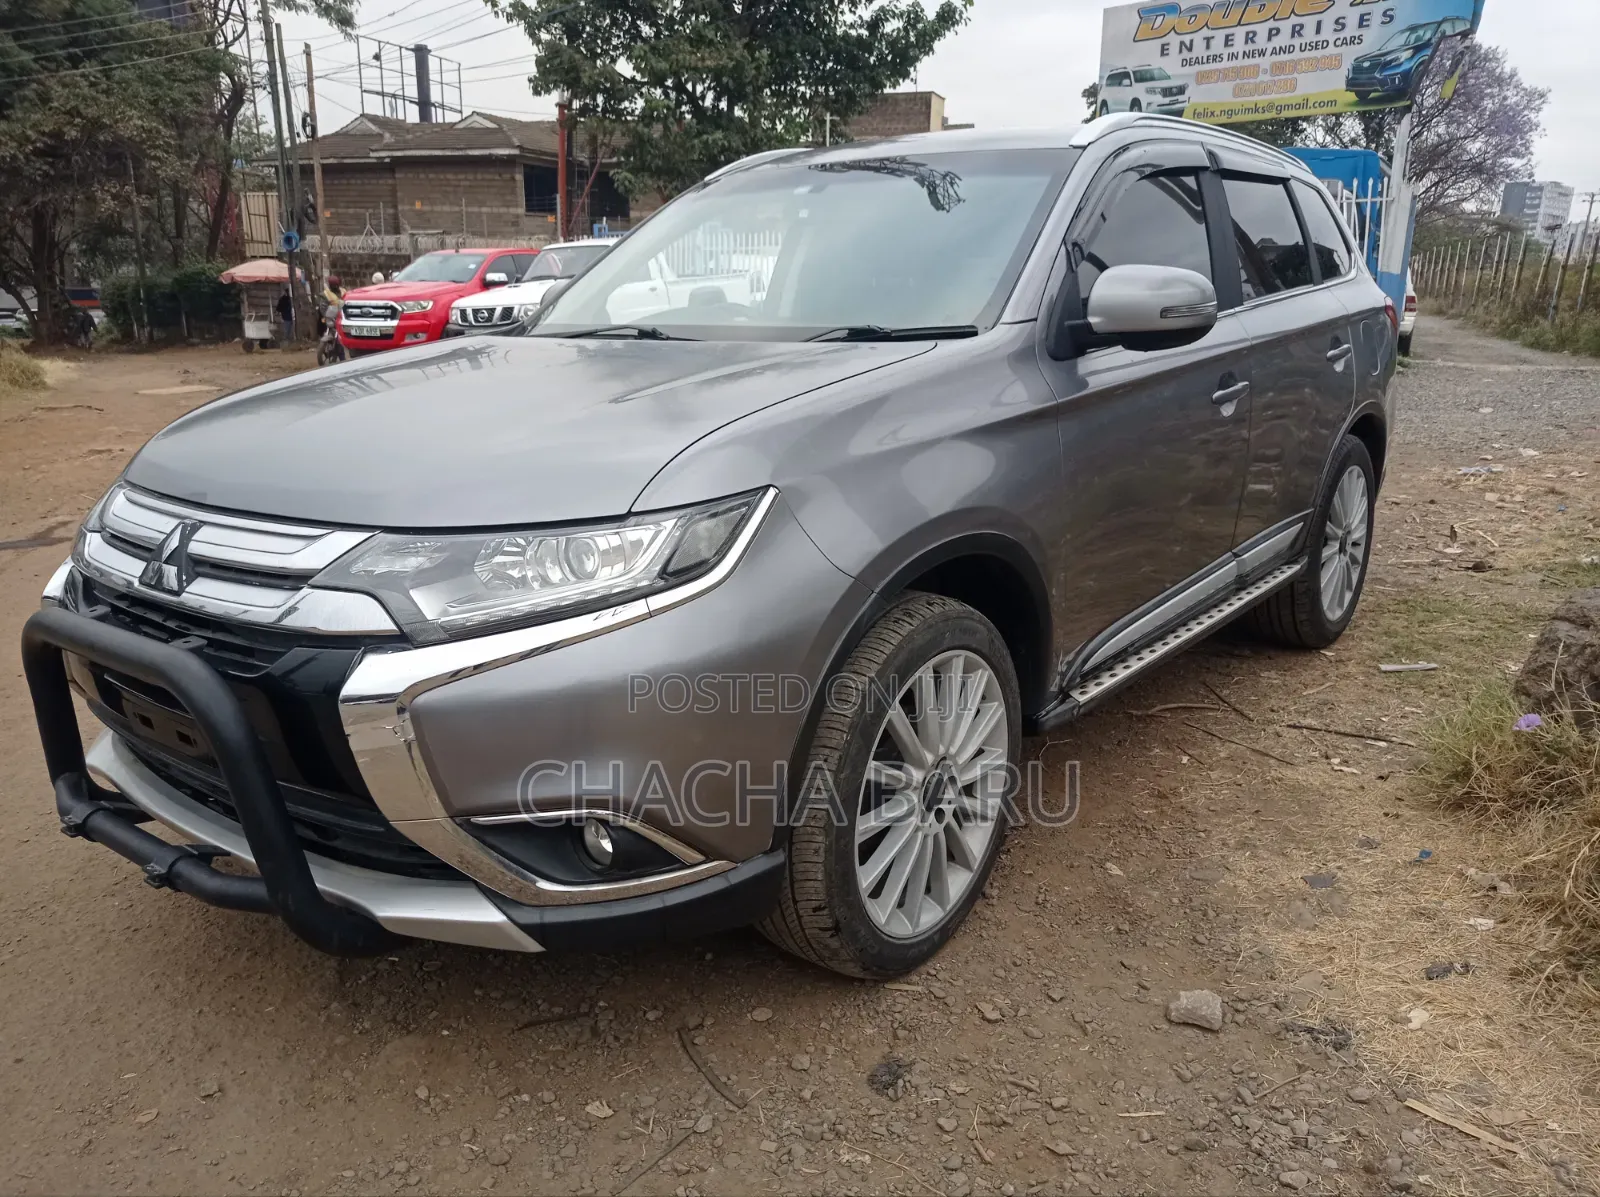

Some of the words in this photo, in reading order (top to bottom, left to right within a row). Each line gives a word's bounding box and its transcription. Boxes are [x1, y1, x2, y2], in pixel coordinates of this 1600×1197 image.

[1160, 8, 1396, 57] ENTERPRISES
[1181, 53, 1223, 67] DEALERS
[1226, 52, 1238, 62] IN
[1242, 48, 1267, 60] NEW
[1270, 44, 1295, 57] AND
[1299, 40, 1330, 52] USED
[1333, 34, 1364, 48] CARS
[1192, 97, 1338, 120] felix.nguimks@gmail.com
